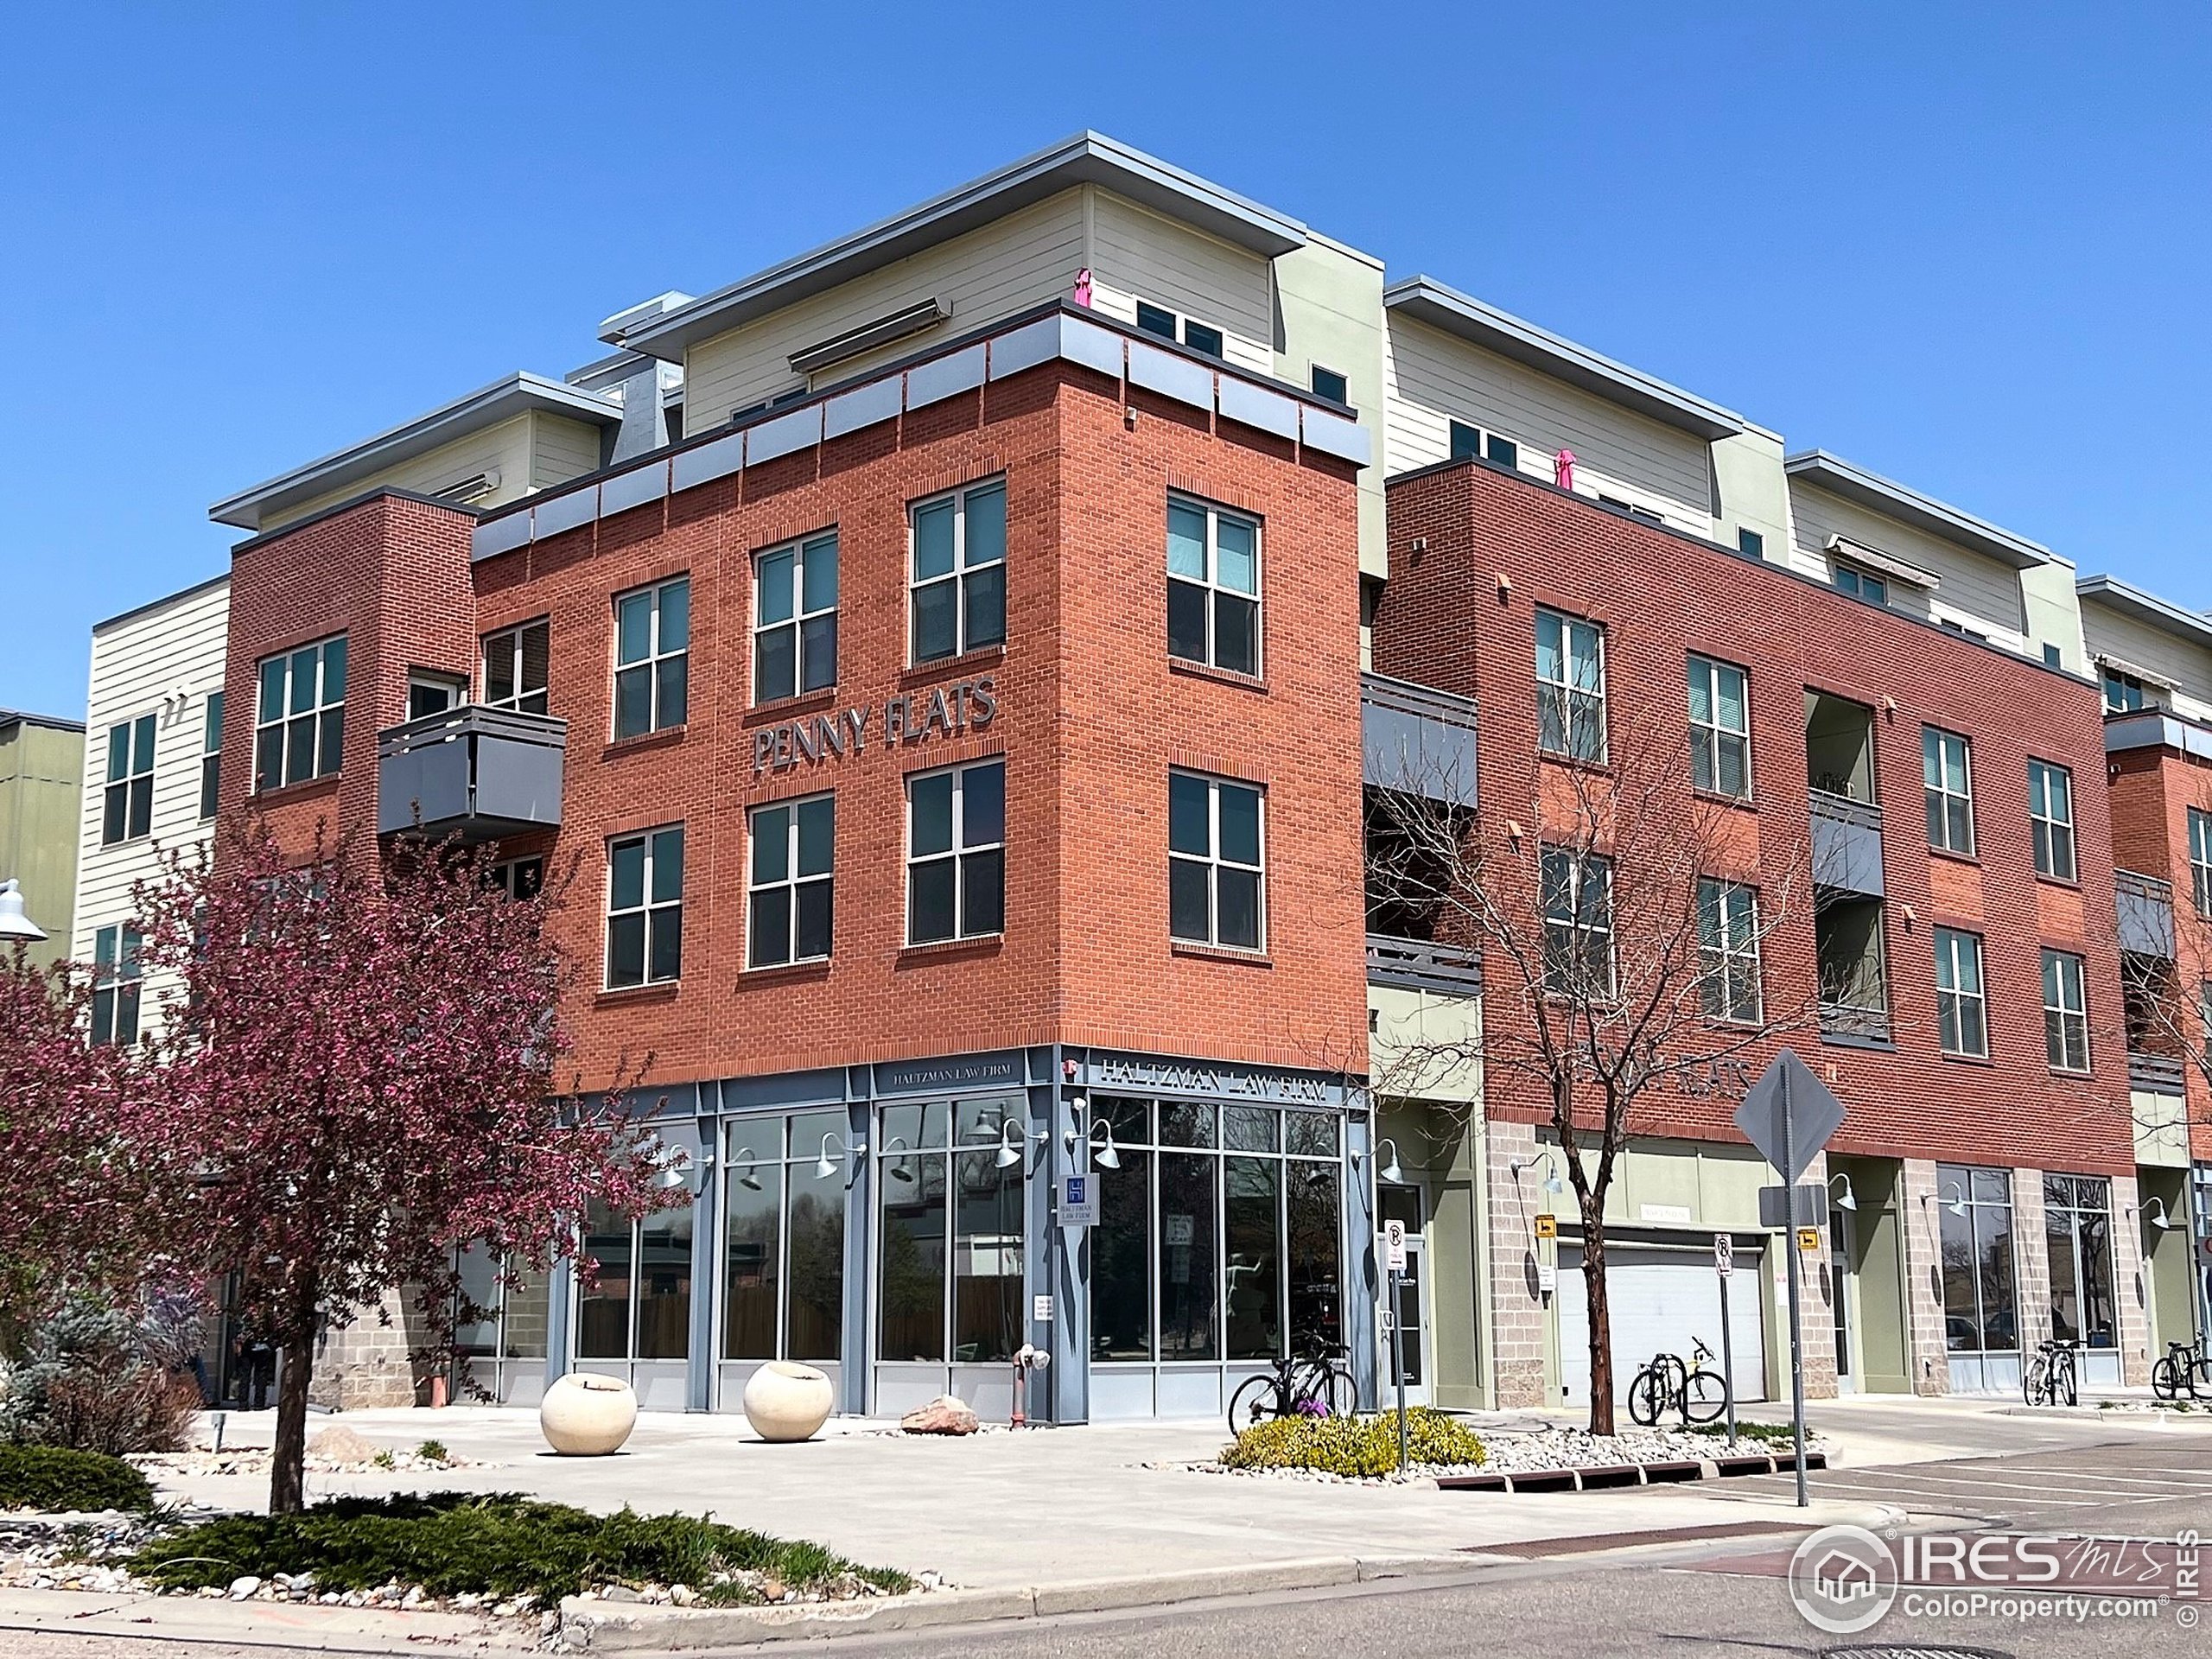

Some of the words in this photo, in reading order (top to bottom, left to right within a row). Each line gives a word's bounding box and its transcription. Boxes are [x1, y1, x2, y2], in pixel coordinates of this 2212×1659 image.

[754, 705, 871, 771] PENNY
[885, 676, 996, 742] FLATS
[893, 1070, 953, 1086] HALTZMAN
[955, 1066, 981, 1080] LAW
[982, 1064, 1011, 1077] FIRM
[1102, 1058, 1222, 1092] HALTZMAN
[1228, 1071, 1273, 1096] LAW
[1279, 1076, 1327, 1101] FIRM
